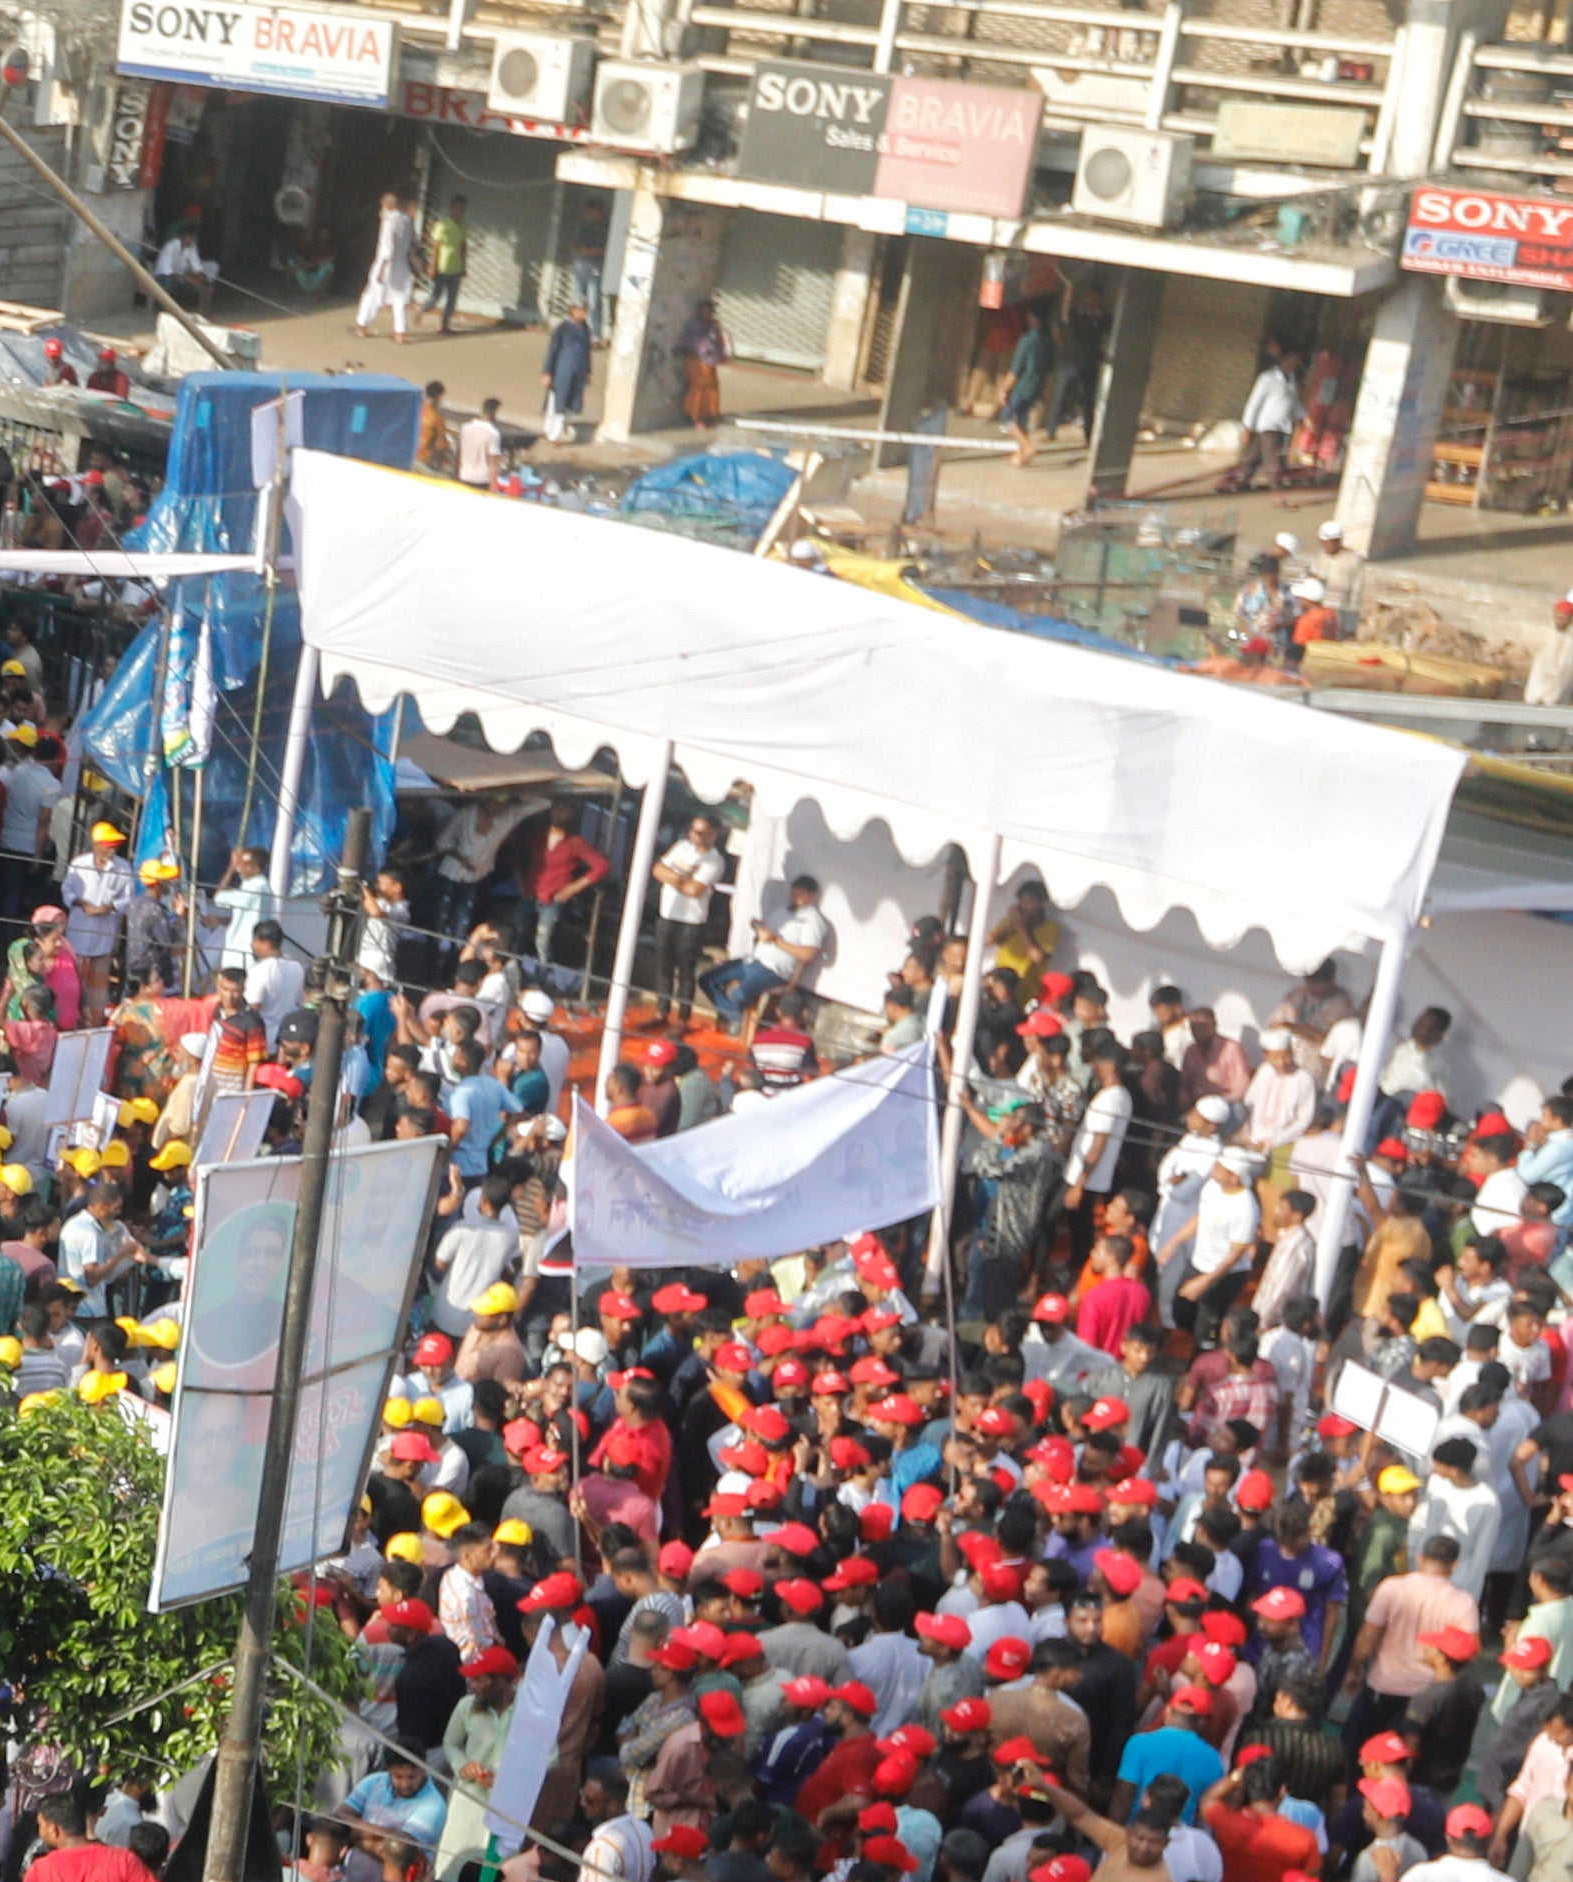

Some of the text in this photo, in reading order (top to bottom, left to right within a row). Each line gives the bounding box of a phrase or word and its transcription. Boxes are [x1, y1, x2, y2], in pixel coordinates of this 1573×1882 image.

[129, 3, 381, 65] SONY BRAVIA
[112, 87, 143, 188] SONY
[754, 71, 1026, 144] SONY BRAVIA
[825, 125, 961, 165] Sales & Service
[1416, 192, 1573, 237] SONY
